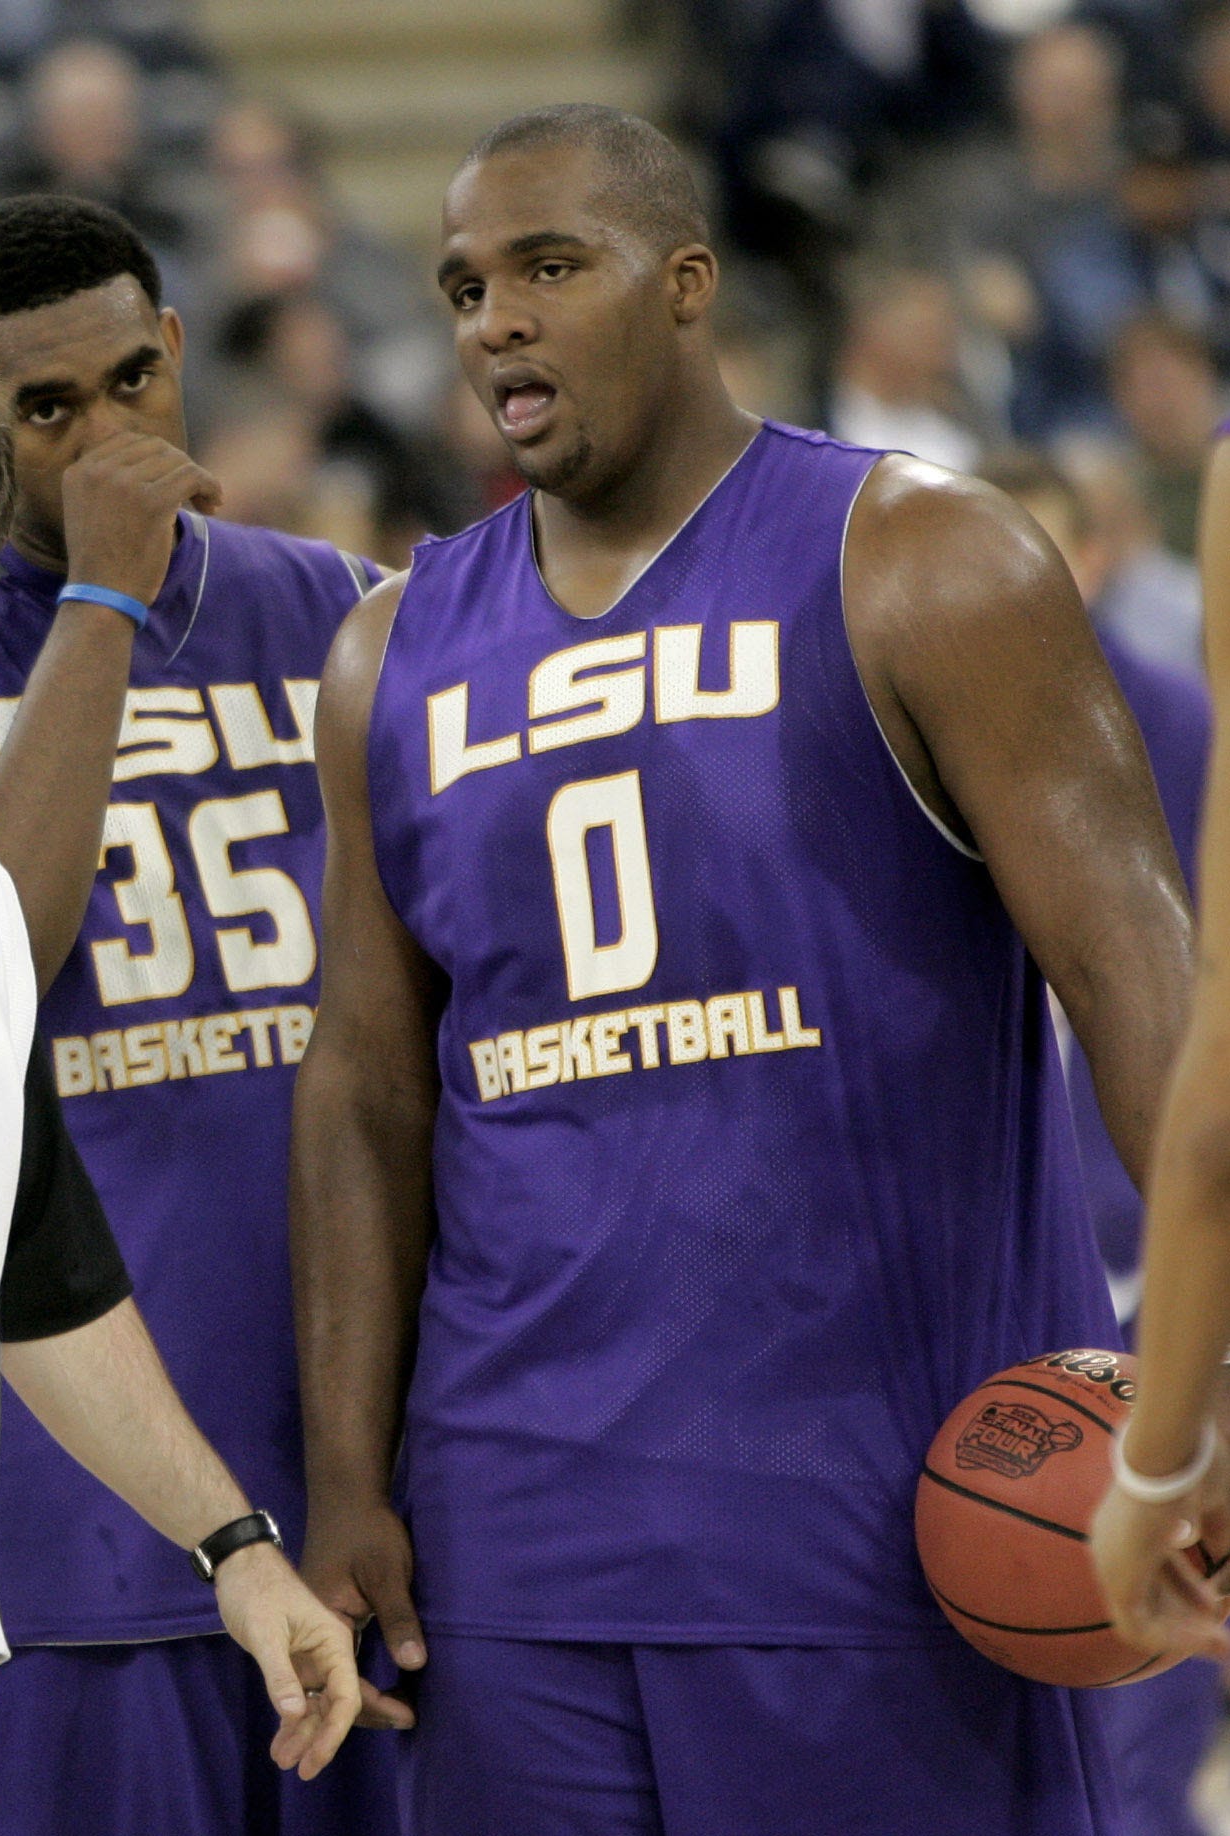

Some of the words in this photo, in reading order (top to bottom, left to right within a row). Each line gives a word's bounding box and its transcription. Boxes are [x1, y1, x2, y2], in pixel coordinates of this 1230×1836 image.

[426, 620, 781, 797] LSU
[91, 789, 317, 1007] 35
[546, 768, 659, 1002] 0
[52, 1004, 318, 1098] BASKETB
[469, 986, 822, 1103] BASKETBALL
[965, 1421, 1041, 1463] FOUR
